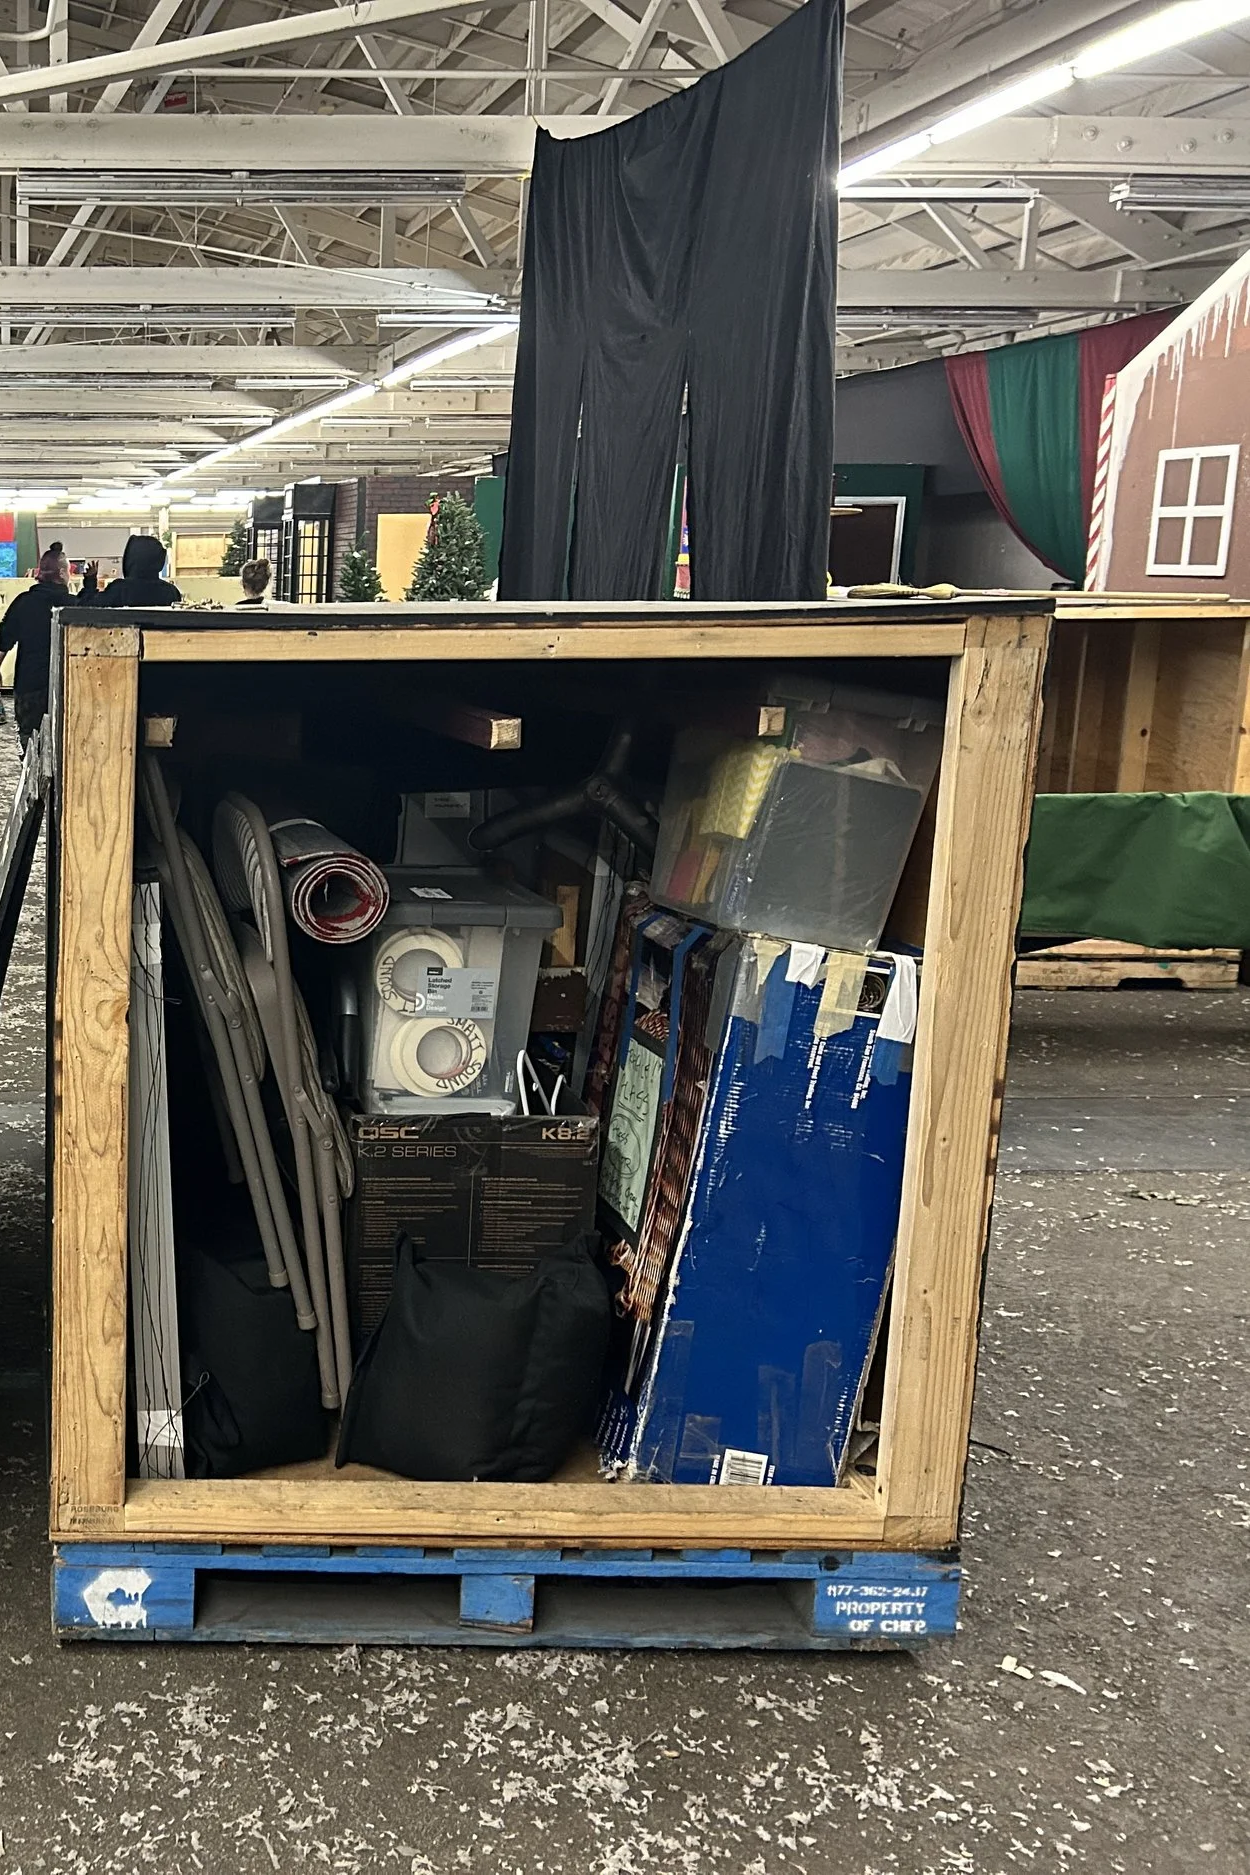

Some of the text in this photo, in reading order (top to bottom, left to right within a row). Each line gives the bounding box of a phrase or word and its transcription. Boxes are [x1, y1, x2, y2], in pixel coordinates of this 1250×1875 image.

[379, 955, 398, 1001] SOUND
[866, 1029, 876, 1045] South
[864, 1044, 872, 1056] San
[436, 1060, 482, 1092] SOUND
[358, 1126, 420, 1141] QSC
[357, 1145, 457, 1158] K.2 SERIES
[835, 1601, 926, 1616] PROPERTY
[849, 1619, 927, 1634] OF CHEP
